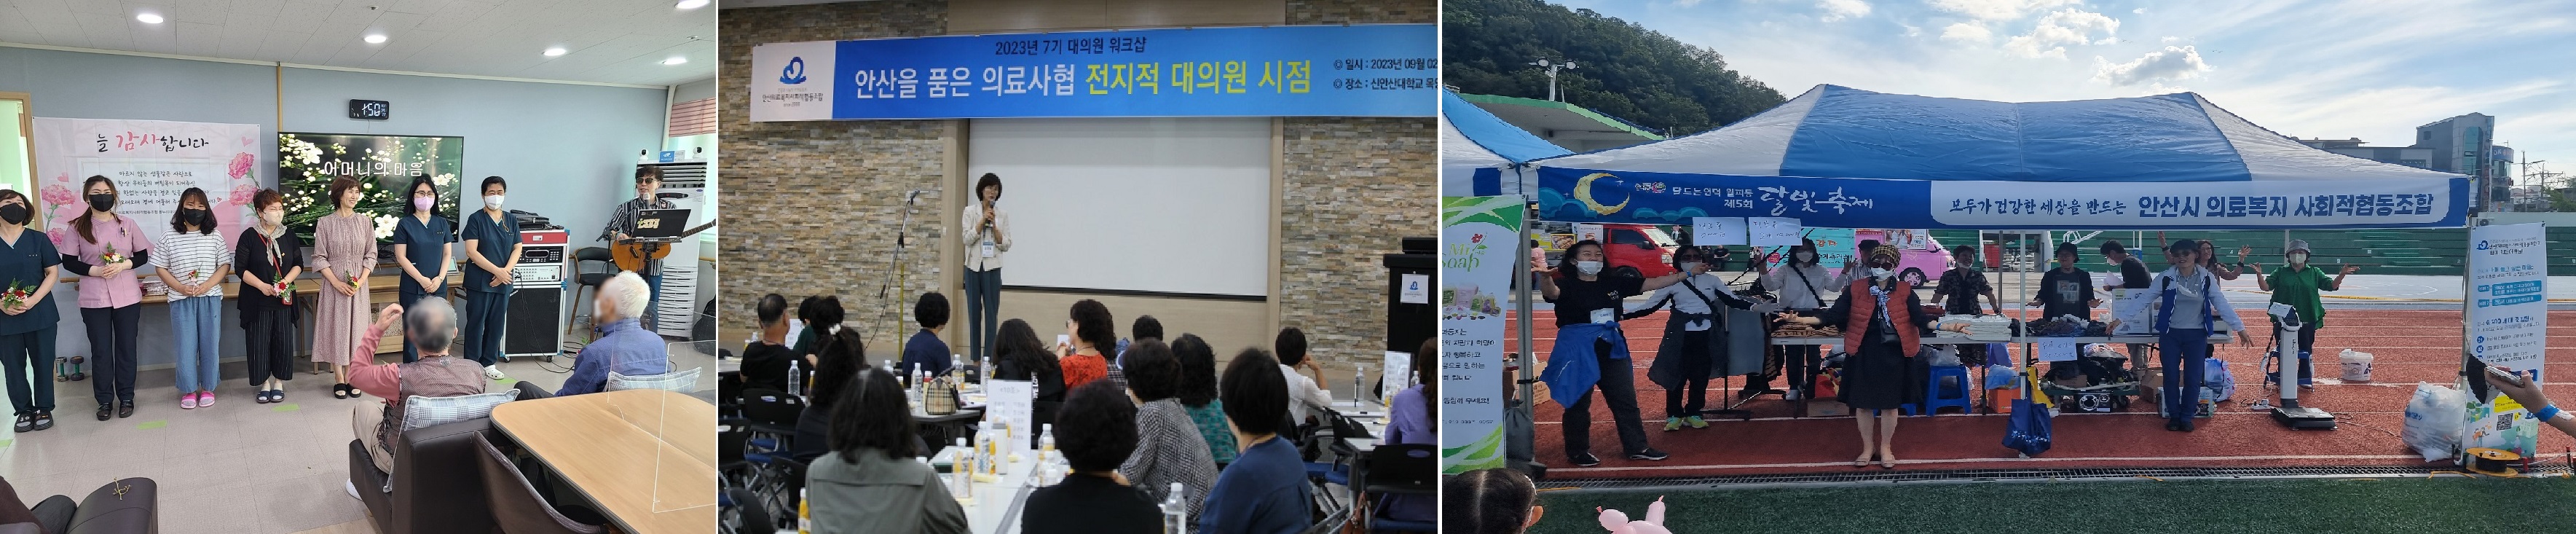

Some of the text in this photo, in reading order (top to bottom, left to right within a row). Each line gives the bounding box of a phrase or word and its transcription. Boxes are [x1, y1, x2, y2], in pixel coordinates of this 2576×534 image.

[996, 36, 1146, 55] 2023년 7기 대의원 워크샵
[1345, 58, 1363, 70] 일시
[1371, 58, 1401, 70] 2023년
[855, 60, 1310, 99] 안산을 품은 의료사협 전지적 대의원 시점
[1345, 78, 1363, 90] 장소
[1371, 78, 1423, 90] 신안산대학교
[97, 131, 209, 152] 늘 감사합니다
[324, 161, 423, 177] 어머니의 마음
[1724, 199, 1753, 209] 제5회
[1757, 186, 1873, 216] 달빛축제
[1950, 198, 2127, 216] 모두가 건강한 세상을 만드는
[2139, 193, 2434, 219] 안산시 의료복지 사회적협동조합
[1449, 243, 1470, 255] Mi
